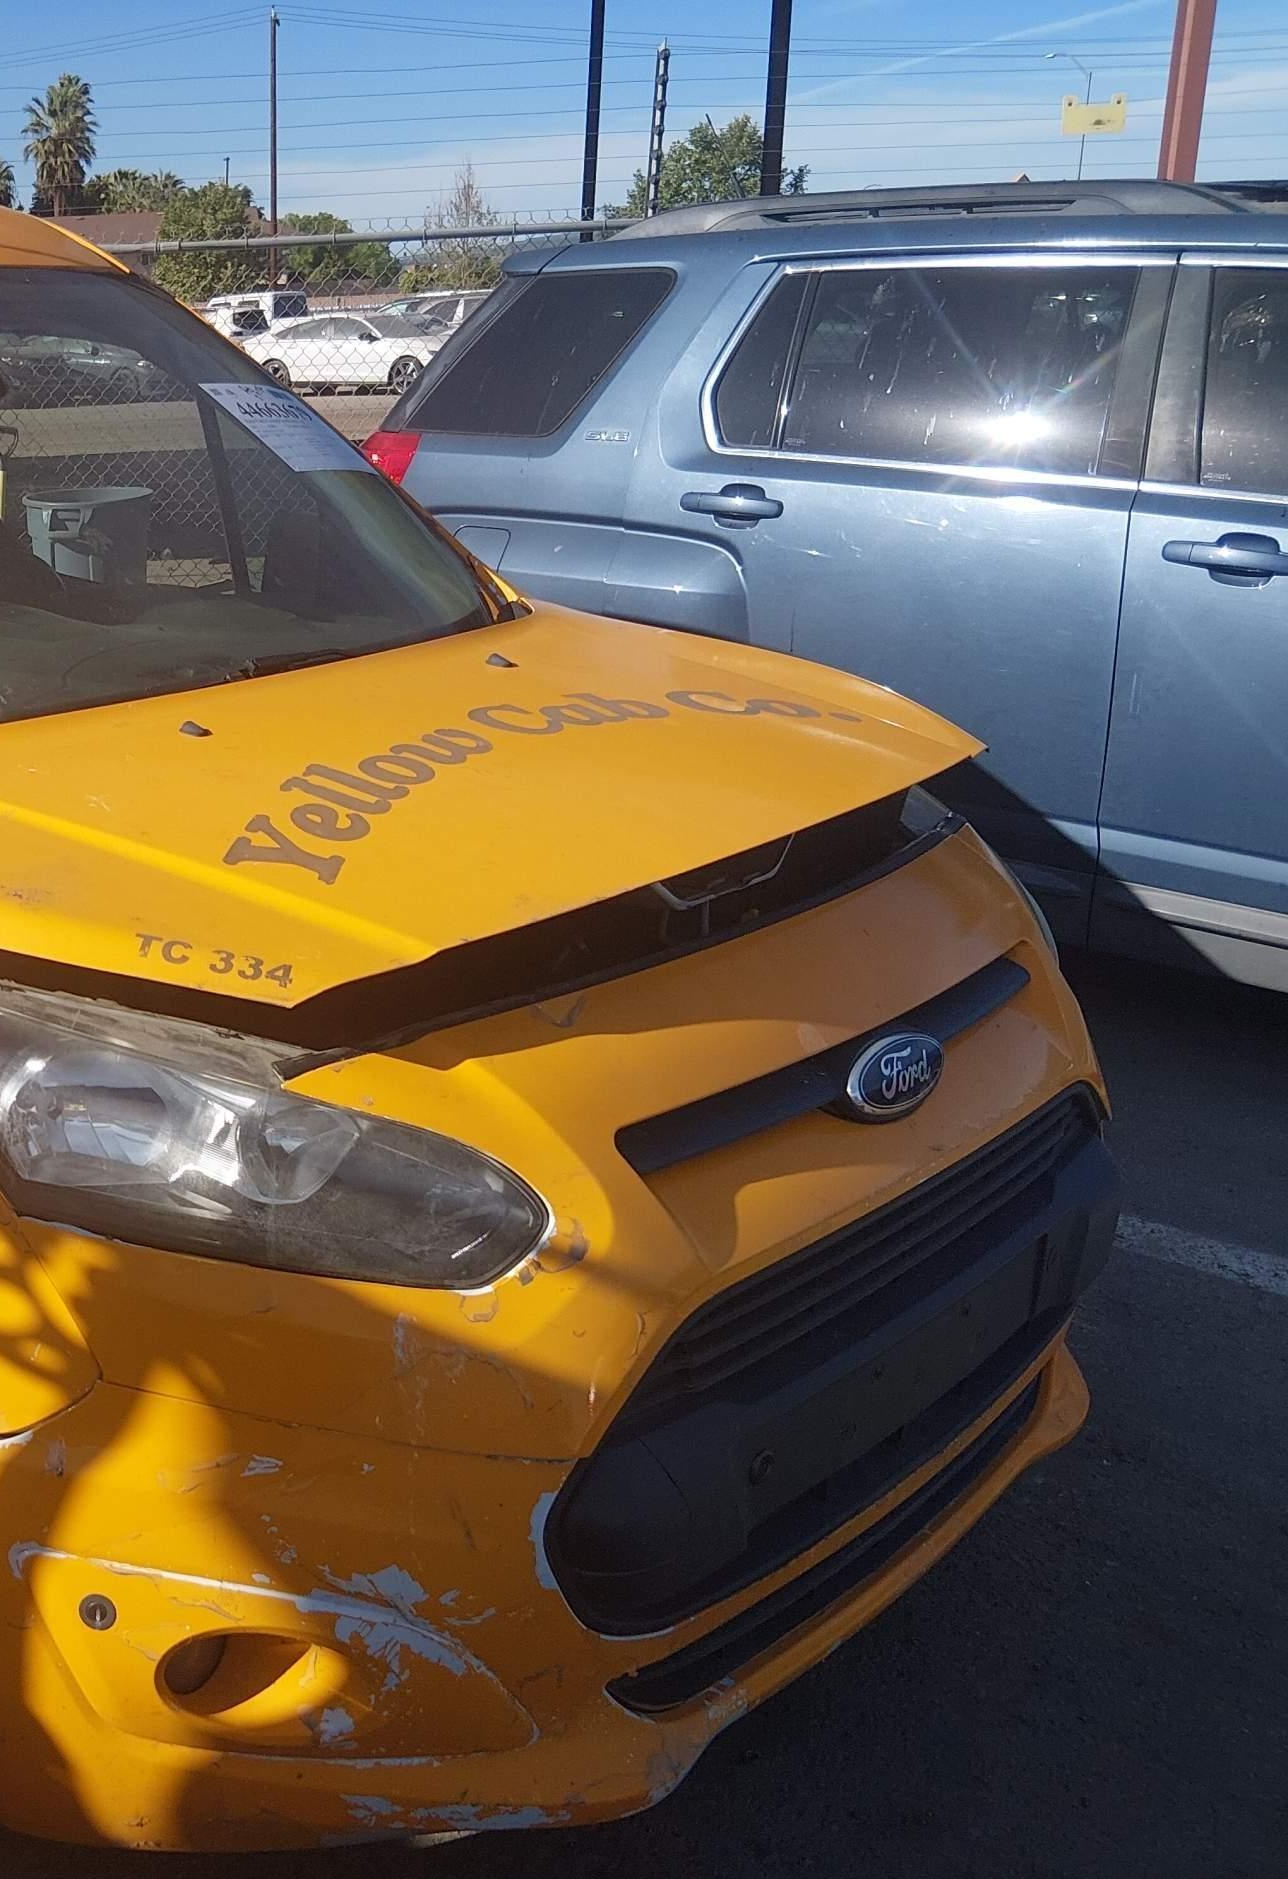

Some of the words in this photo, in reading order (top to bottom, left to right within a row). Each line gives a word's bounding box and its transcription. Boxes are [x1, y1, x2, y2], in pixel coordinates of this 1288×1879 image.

[222, 727, 494, 885] Yellow
[466, 692, 670, 735] Cab
[664, 690, 863, 723] Co.
[135, 932, 194, 965] TC
[208, 949, 294, 989] 334
[879, 1045, 932, 1100] Ford
